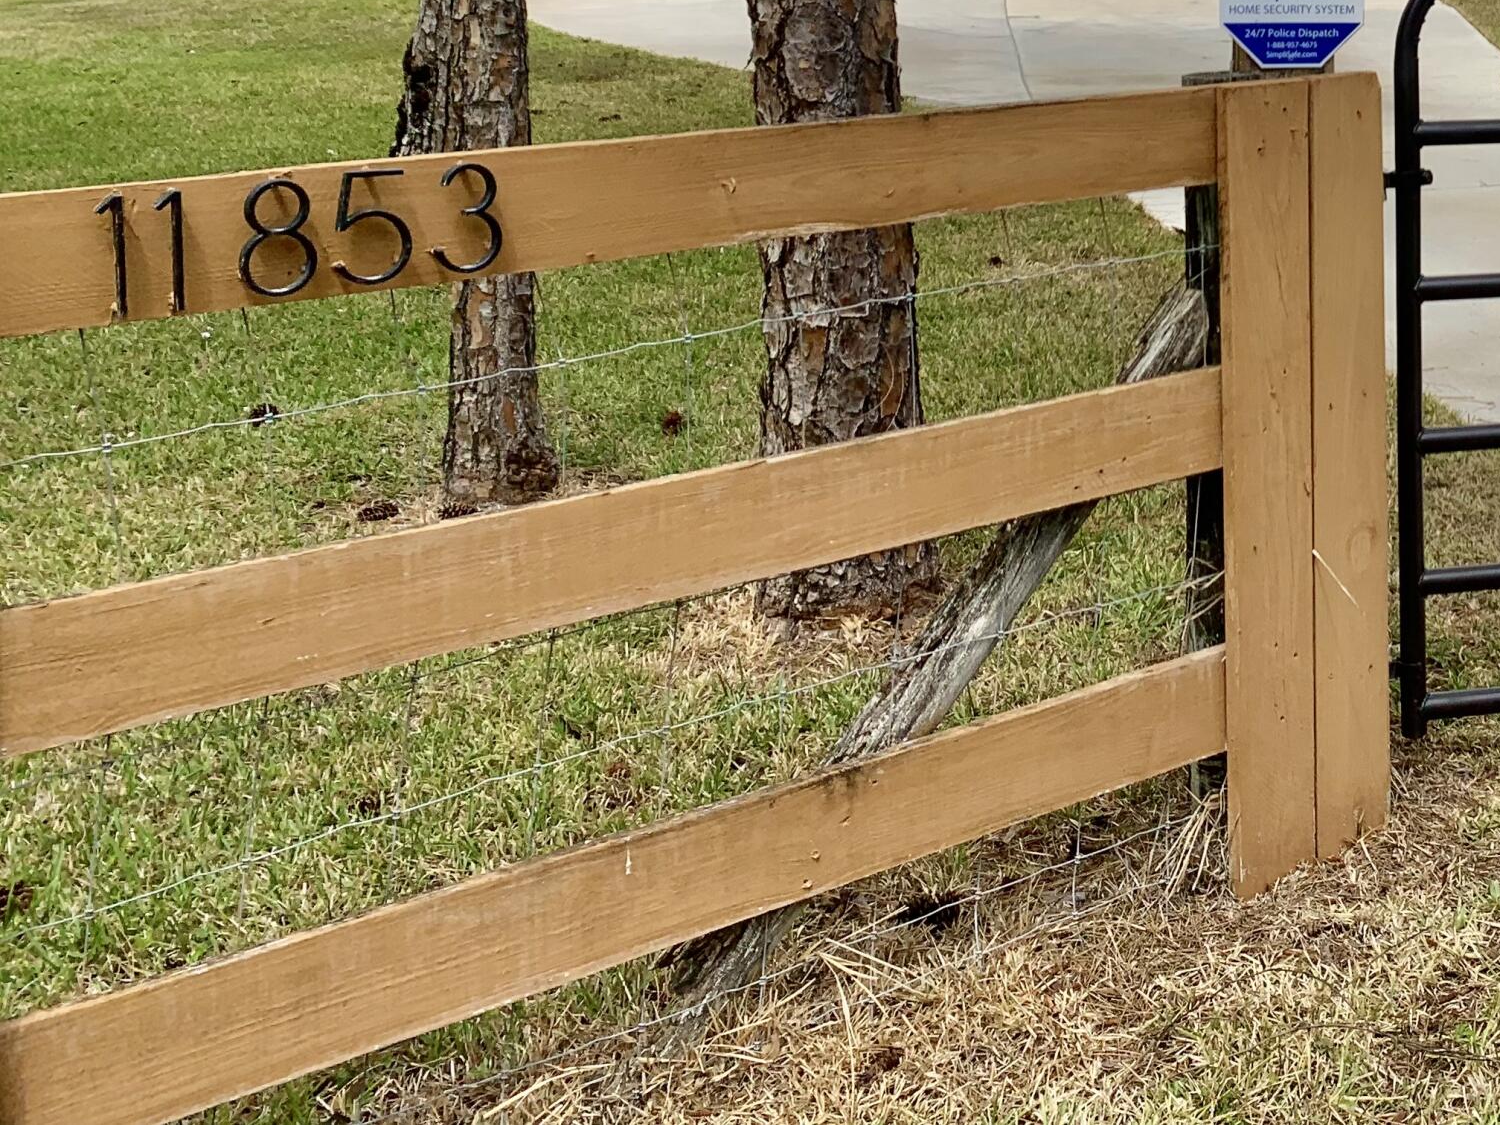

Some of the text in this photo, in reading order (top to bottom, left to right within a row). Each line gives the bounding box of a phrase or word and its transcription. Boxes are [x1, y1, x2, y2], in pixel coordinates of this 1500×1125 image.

[1229, 5, 1355, 14] HOME SECURITY SYSTEM
[1244, 28, 1339, 39] 24/7 Police Dispatch
[1266, 50, 1317, 59] SimpliSafe.com
[94, 161, 503, 321] 11853
